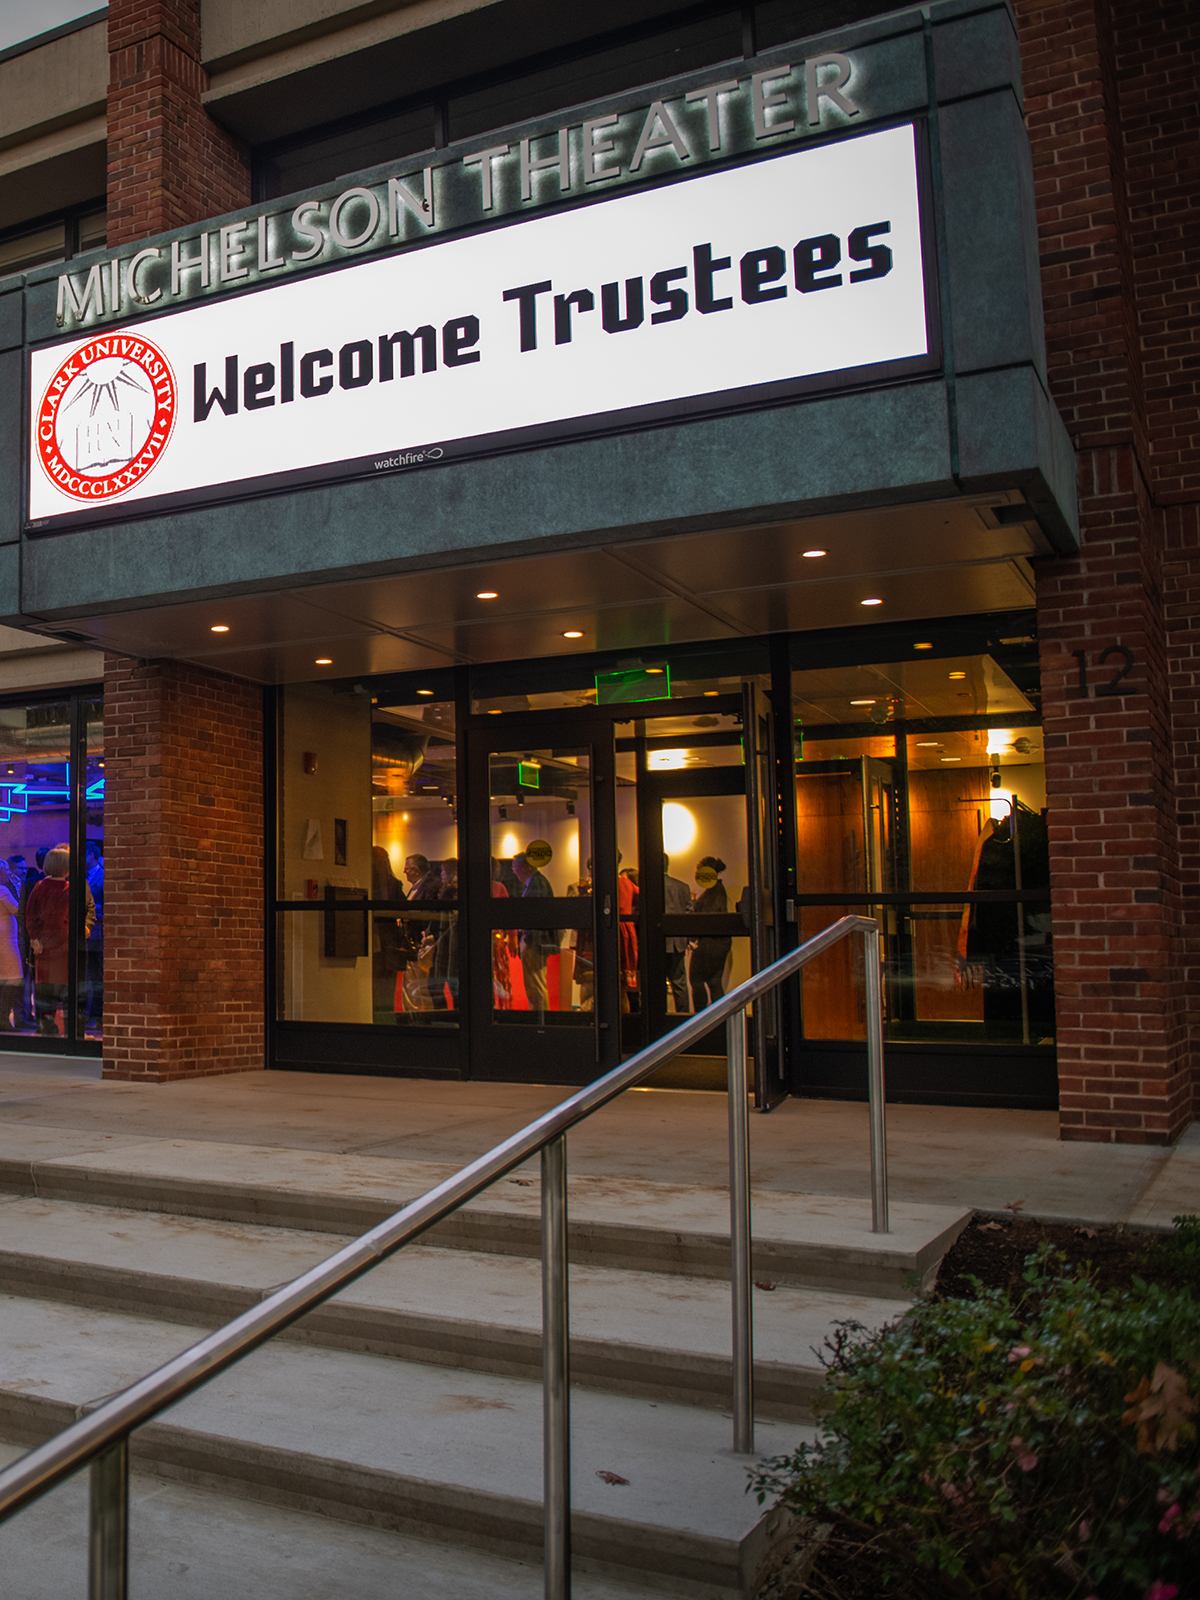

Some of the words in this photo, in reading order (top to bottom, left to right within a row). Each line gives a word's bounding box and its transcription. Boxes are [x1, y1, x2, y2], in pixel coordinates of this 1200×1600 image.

[56, 167, 435, 328] MICHELSON
[463, 53, 860, 211] THEATER
[193, 313, 481, 423] Welcome
[502, 220, 893, 354] Trustees
[40, 358, 80, 441] CLARK
[80, 338, 172, 413] UNIVERSITY
[48, 431, 165, 496] MDCCCLXXXVII
[374, 452, 424, 470] watchfire
[1071, 645, 1137, 698] 12
